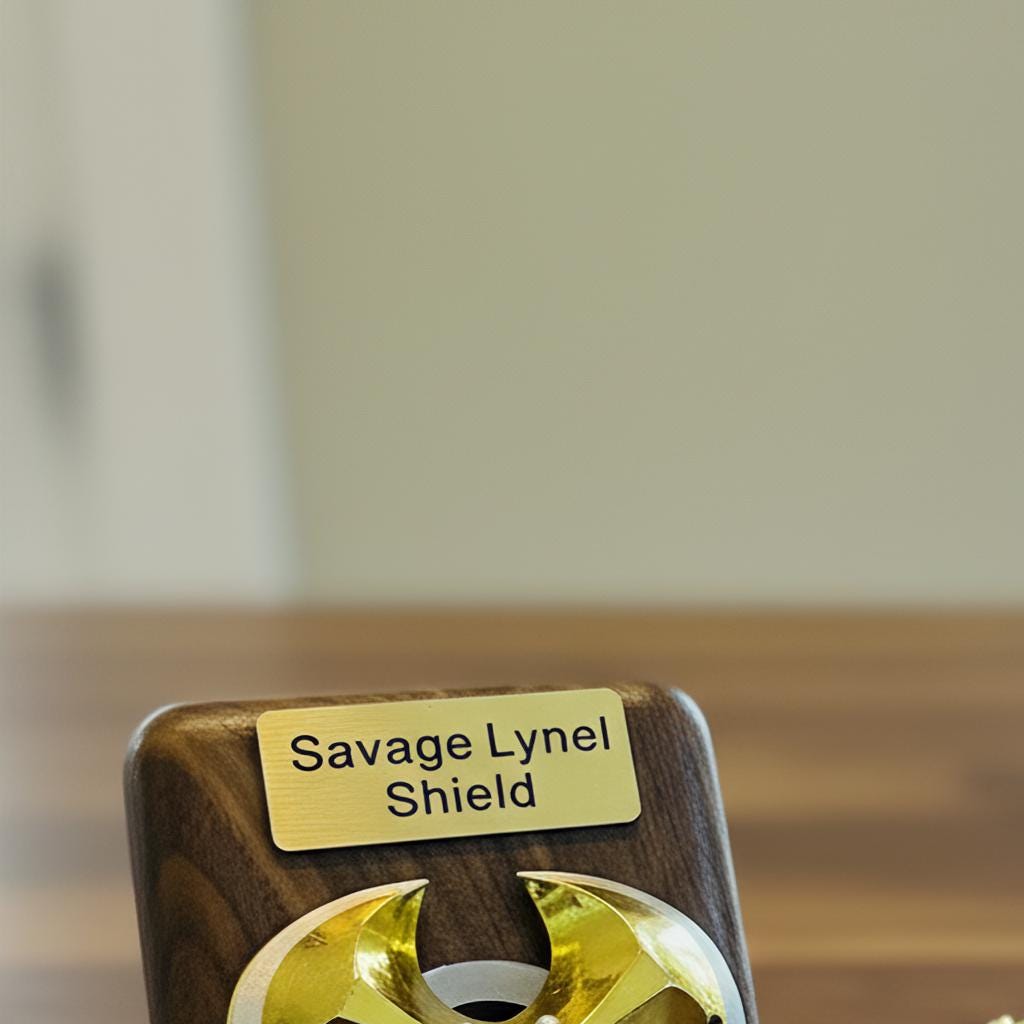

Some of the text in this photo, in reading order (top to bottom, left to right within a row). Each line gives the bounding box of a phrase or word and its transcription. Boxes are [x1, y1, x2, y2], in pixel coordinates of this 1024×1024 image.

[290, 715, 611, 773] Savage Lynel
[386, 772, 537, 819] Shield
